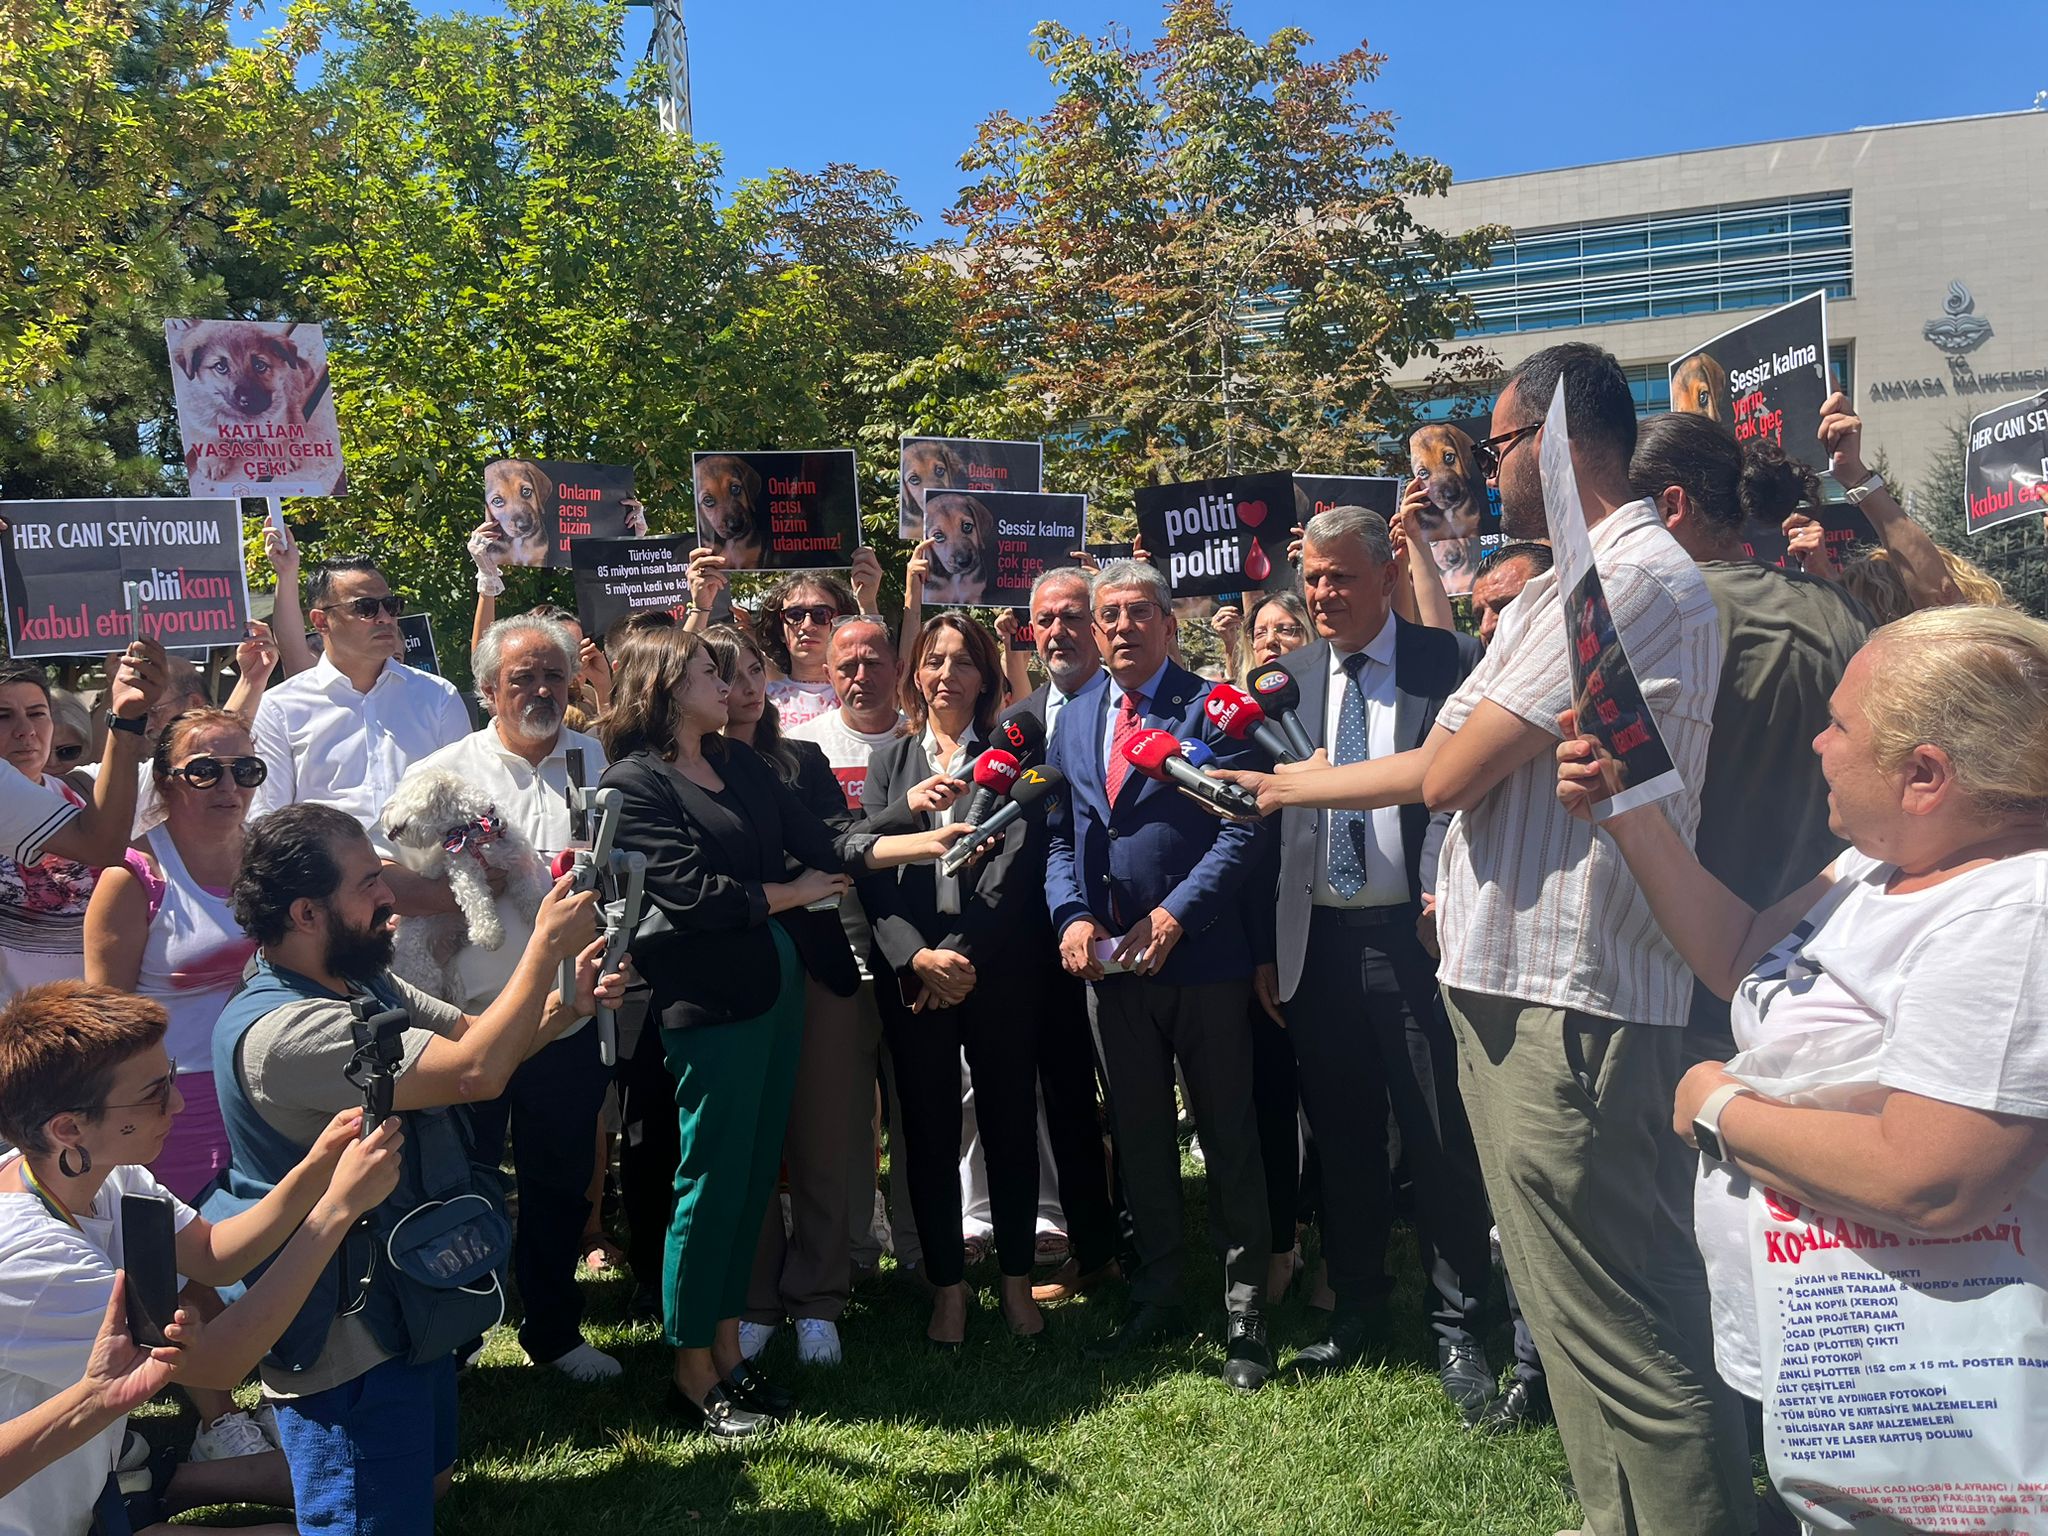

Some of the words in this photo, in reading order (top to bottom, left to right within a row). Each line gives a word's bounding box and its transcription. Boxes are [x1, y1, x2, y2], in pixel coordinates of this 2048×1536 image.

[1730, 359, 1771, 393] Sessiz
[1773, 344, 1816, 376] kalma
[1868, 378, 1946, 399] ANAYASA
[218, 421, 305, 438] KATLİAM
[1759, 409, 1783, 438] geç
[1972, 427, 1992, 452] HER
[1994, 416, 2026, 442] CANI
[192, 443, 283, 457] YASASINI
[289, 439, 334, 457] GERİ
[244, 461, 288, 479] ÇEK!
[968, 463, 1008, 479] Onların
[559, 483, 600, 500] Onların
[768, 477, 816, 495] Onların
[770, 500, 801, 513] acısı
[1970, 480, 2014, 519] kabul
[559, 504, 587, 517] acısı
[559, 518, 591, 535] bizim
[771, 515, 807, 532] bizim
[998, 519, 1036, 536] Sessiz
[1039, 521, 1075, 537] kalma
[1165, 493, 1237, 546] politi
[12, 523, 53, 549] HER
[57, 521, 103, 548] CANI
[107, 516, 221, 547] SEVİYORUM
[1825, 529, 1855, 542] arın
[773, 532, 841, 551] utancımız!
[997, 540, 1027, 555] yarın
[628, 549, 672, 563] Türkiye'de
[998, 555, 1019, 571] çok
[1022, 558, 1043, 573] geç
[1170, 536, 1240, 589] politi
[597, 566, 609, 577] 85
[611, 564, 640, 579] milyon
[641, 563, 665, 574] insan
[666, 562, 688, 573] barın
[605, 584, 611, 595] 5
[613, 582, 642, 596] milyon
[644, 580, 662, 592] kedi
[665, 582, 675, 591] ve
[997, 573, 1036, 588] olabili
[629, 594, 682, 607] barınamıyor.
[18, 603, 90, 641] kabul
[404, 635, 421, 652] çin
[1260, 673, 1285, 689] SZC
[1216, 702, 1239, 730] anka
[1131, 732, 1163, 755] DHA
[987, 759, 1017, 779] NOW
[1841, 1271, 1885, 1280] RENKLİ
[1889, 1269, 1921, 1281] ÇIKTI
[1795, 1286, 1844, 1298] SCANNER
[1847, 1284, 1896, 1293] TARAMA
[1900, 1282, 1909, 1290] &
[1912, 1279, 1959, 1290] WORD'e
[1962, 1276, 2024, 1287] AKTARMA
[1788, 1300, 1811, 1312] LAN
[1815, 1299, 1847, 1310] KOPYA
[1851, 1297, 1898, 1307] (XEROX)
[1787, 1316, 1812, 1325] LAN
[1816, 1312, 1848, 1323] PROJE
[1850, 1310, 1898, 1320] TARAMA
[1820, 1324, 1869, 1338] (PLOTTER)
[1874, 1322, 1905, 1334] ÇIKTI
[1784, 1343, 1810, 1352] CAD
[1814, 1338, 1863, 1352] (PLOTTER)
[1866, 1336, 1898, 1348] ÇIKTI
[1781, 1354, 1808, 1366] NKLİ
[1812, 1350, 1862, 1364] FOTOKOPİ
[1778, 1368, 1811, 1379] ENKLİ
[1814, 1366, 1860, 1377] PLOTTER
[1865, 1364, 1885, 1375] (152
[1889, 1364, 1906, 1372] cm
[1921, 1360, 1934, 1369] 15
[1938, 1360, 1958, 1368] mt.
[1963, 1357, 2014, 1367] POSTER
[2018, 1357, 2048, 1368] BASK
[1776, 1382, 1797, 1393] CİLT
[1801, 1379, 1856, 1394] ÇEŞİTLERİ
[1779, 1396, 1816, 1406] ASETAT
[1820, 1396, 1834, 1404] VE
[1838, 1392, 1887, 1403] AYDINGER
[1889, 1385, 1947, 1399] FOTOKOPİ
[1781, 1409, 1805, 1420] TÜM
[1808, 1408, 1836, 1418] BÜRO
[1840, 1408, 1855, 1417] VE
[1857, 1403, 1909, 1416] KIRTASİYE
[1912, 1397, 1998, 1412] MALZEMELERİ
[1785, 1421, 1845, 1433] BİLGİSAYAR
[1849, 1422, 1873, 1431] SARF
[1877, 1414, 1954, 1428] MALZEMELERİ
[1788, 1437, 1822, 1447] INKJET
[1825, 1436, 1840, 1445] VE
[1843, 1435, 1877, 1445] LASER
[1879, 1432, 1922, 1443] KARTUŞ
[1926, 1429, 1973, 1440] DOLUMU
[1791, 1451, 1816, 1462] KAŞE
[1818, 1450, 1855, 1460] YAPIMI
[2017, 1483, 2048, 1491] ANKA
